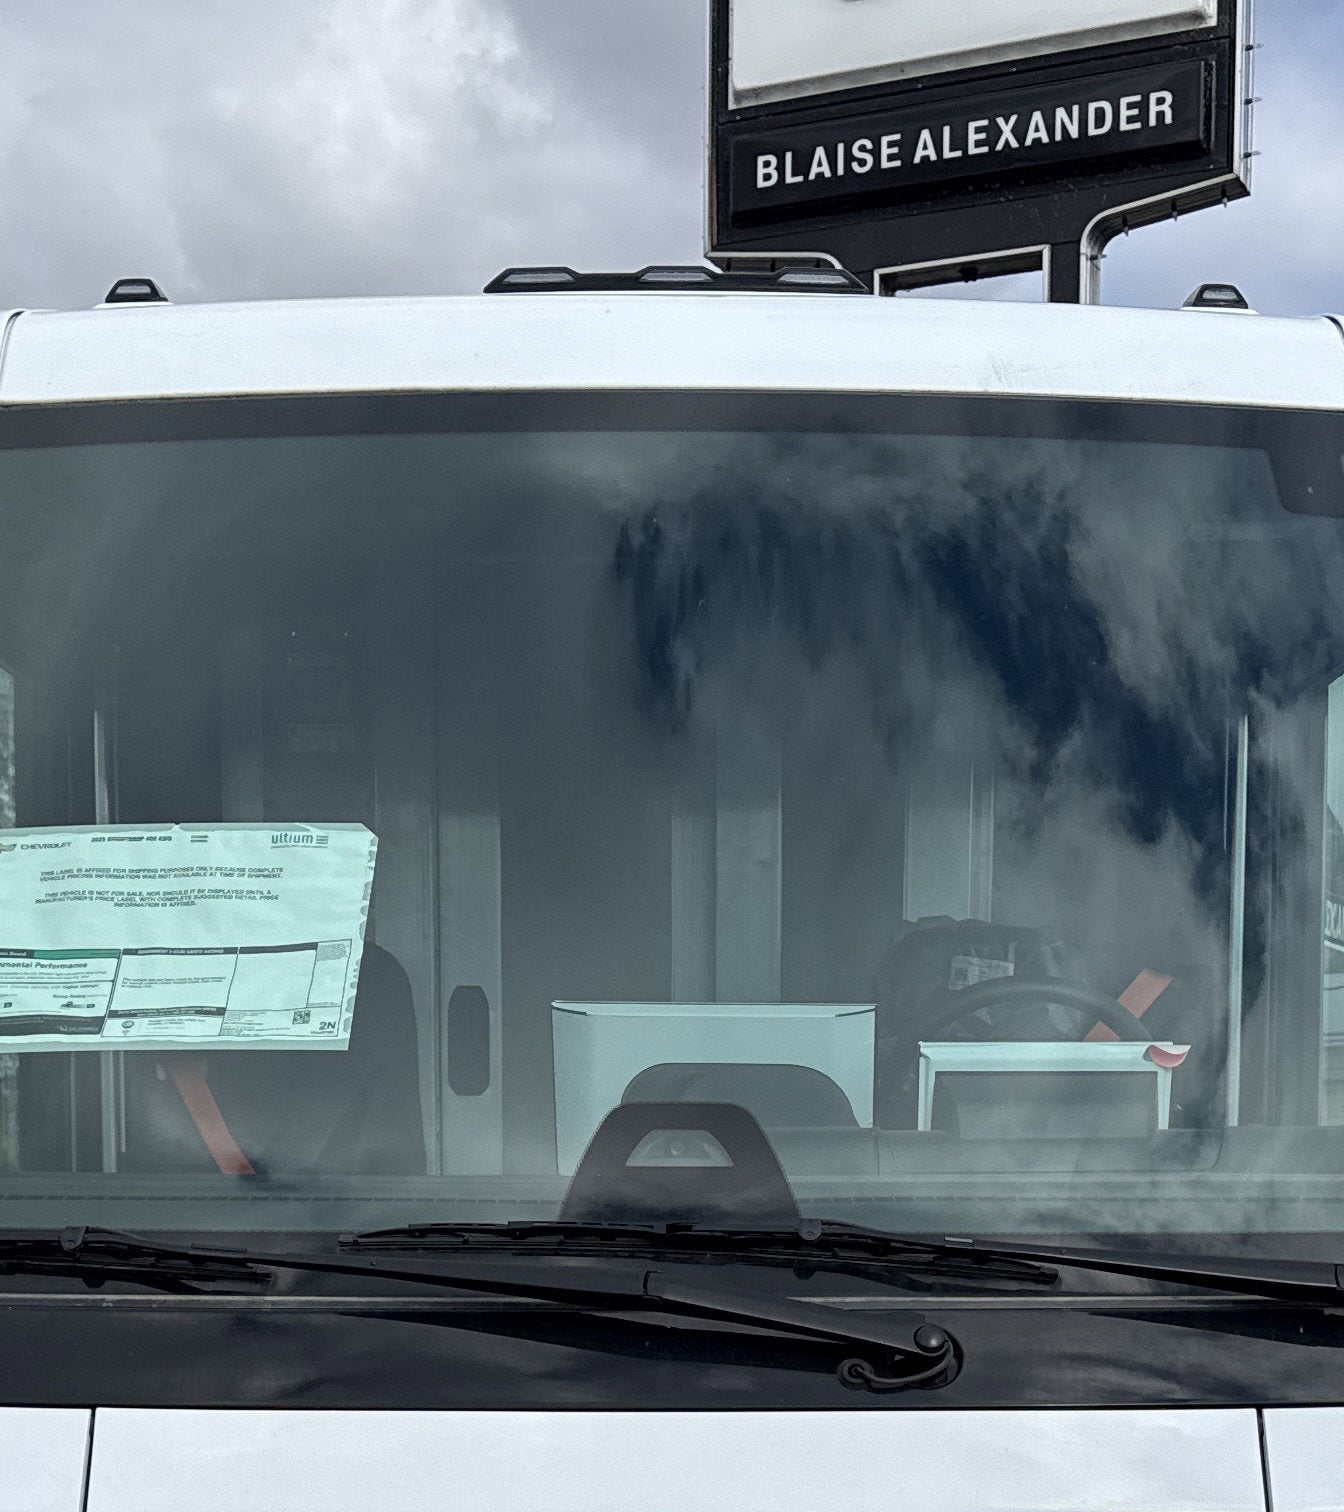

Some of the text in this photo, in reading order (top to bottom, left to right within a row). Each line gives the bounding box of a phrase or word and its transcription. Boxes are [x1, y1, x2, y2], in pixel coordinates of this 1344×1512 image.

[756, 89, 1174, 189] BLAISE ALEXANDER
[271, 832, 314, 844] ultium
[20, 841, 73, 850] CHEVROLET
[55, 868, 75, 876] LABEL
[34, 961, 89, 969] Performance
[319, 1021, 337, 1031] 2N
